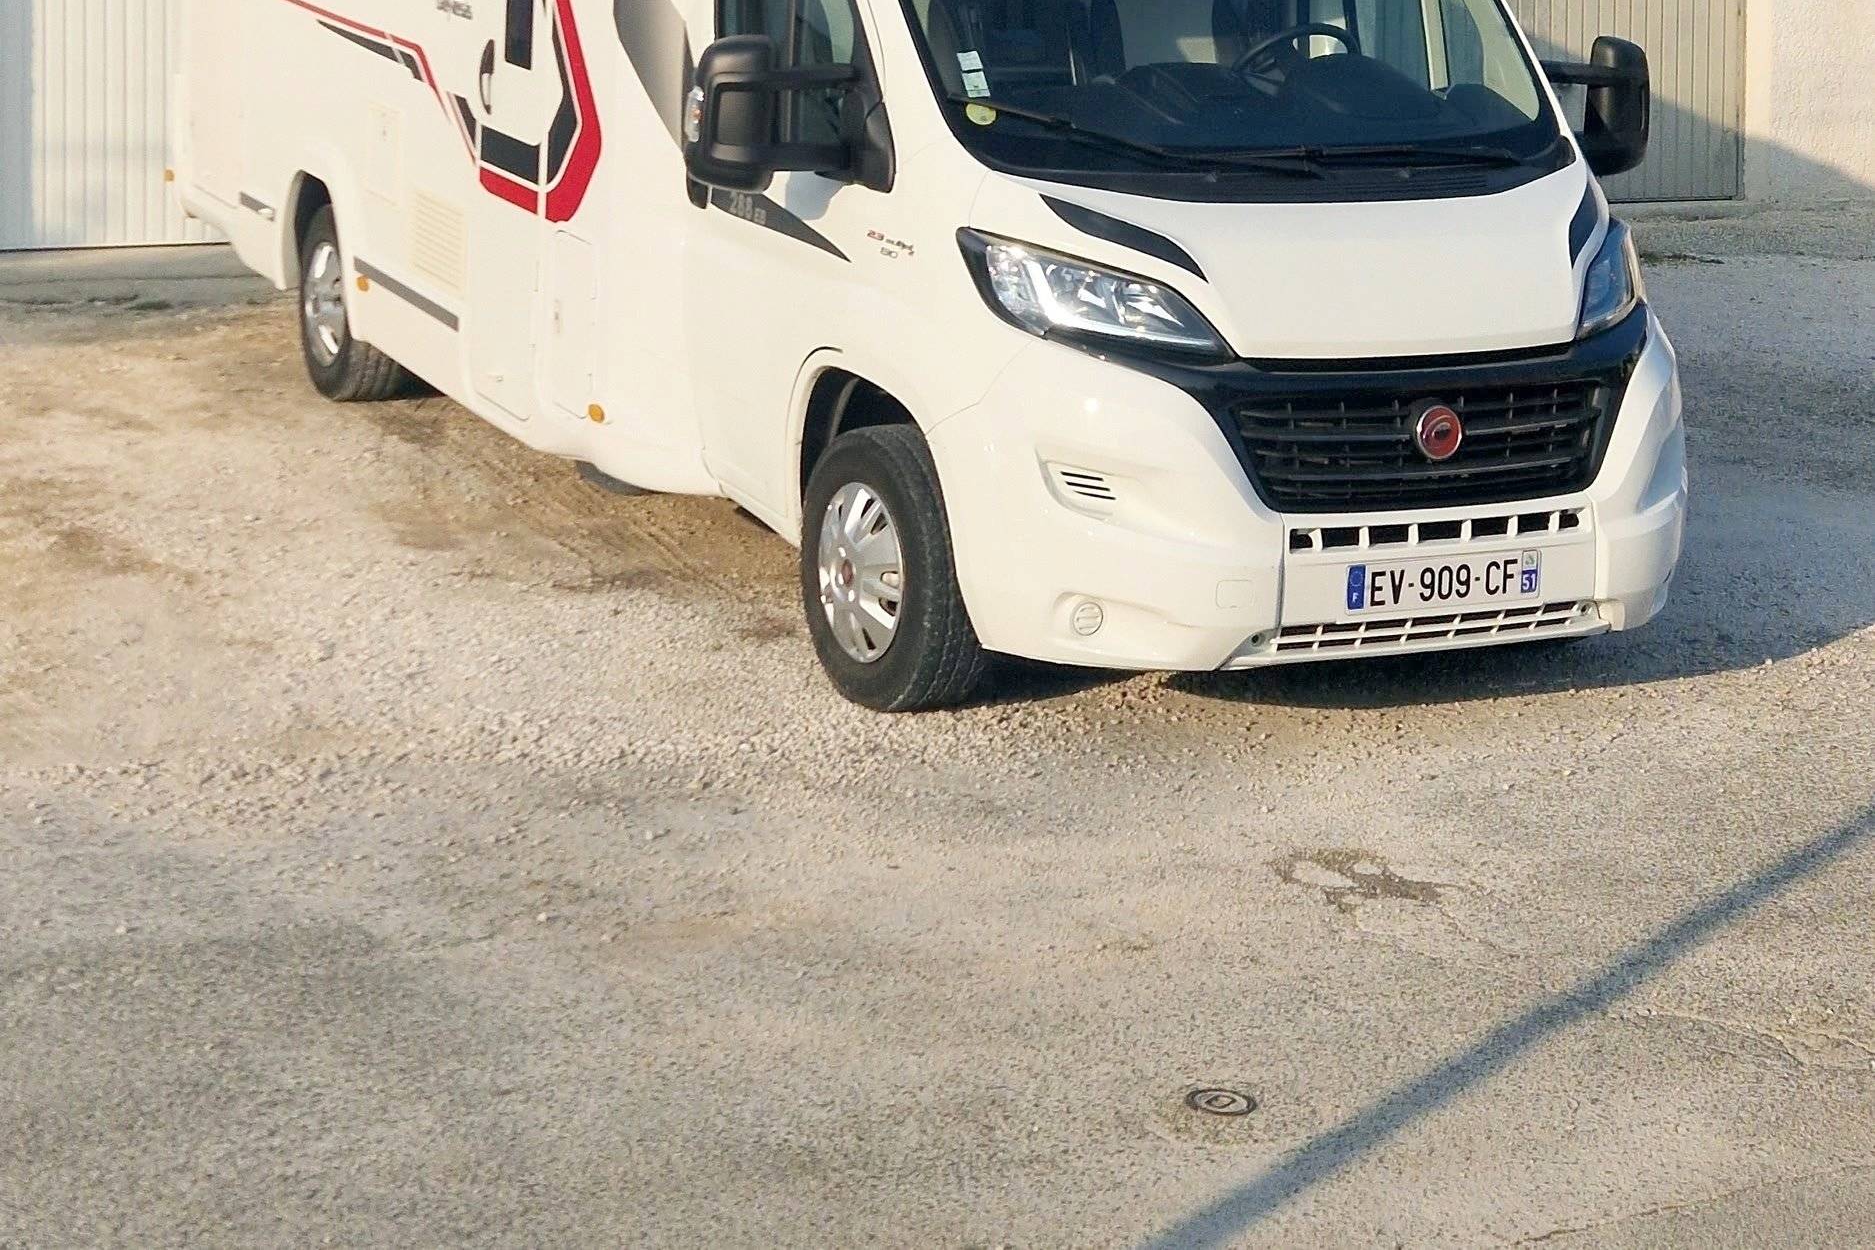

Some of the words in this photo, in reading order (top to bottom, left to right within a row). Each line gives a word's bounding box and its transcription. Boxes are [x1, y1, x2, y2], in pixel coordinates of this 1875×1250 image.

[1352, 593, 1358, 603] F
[1370, 559, 1518, 607] EV-909-CF
[1523, 574, 1536, 590] 51
